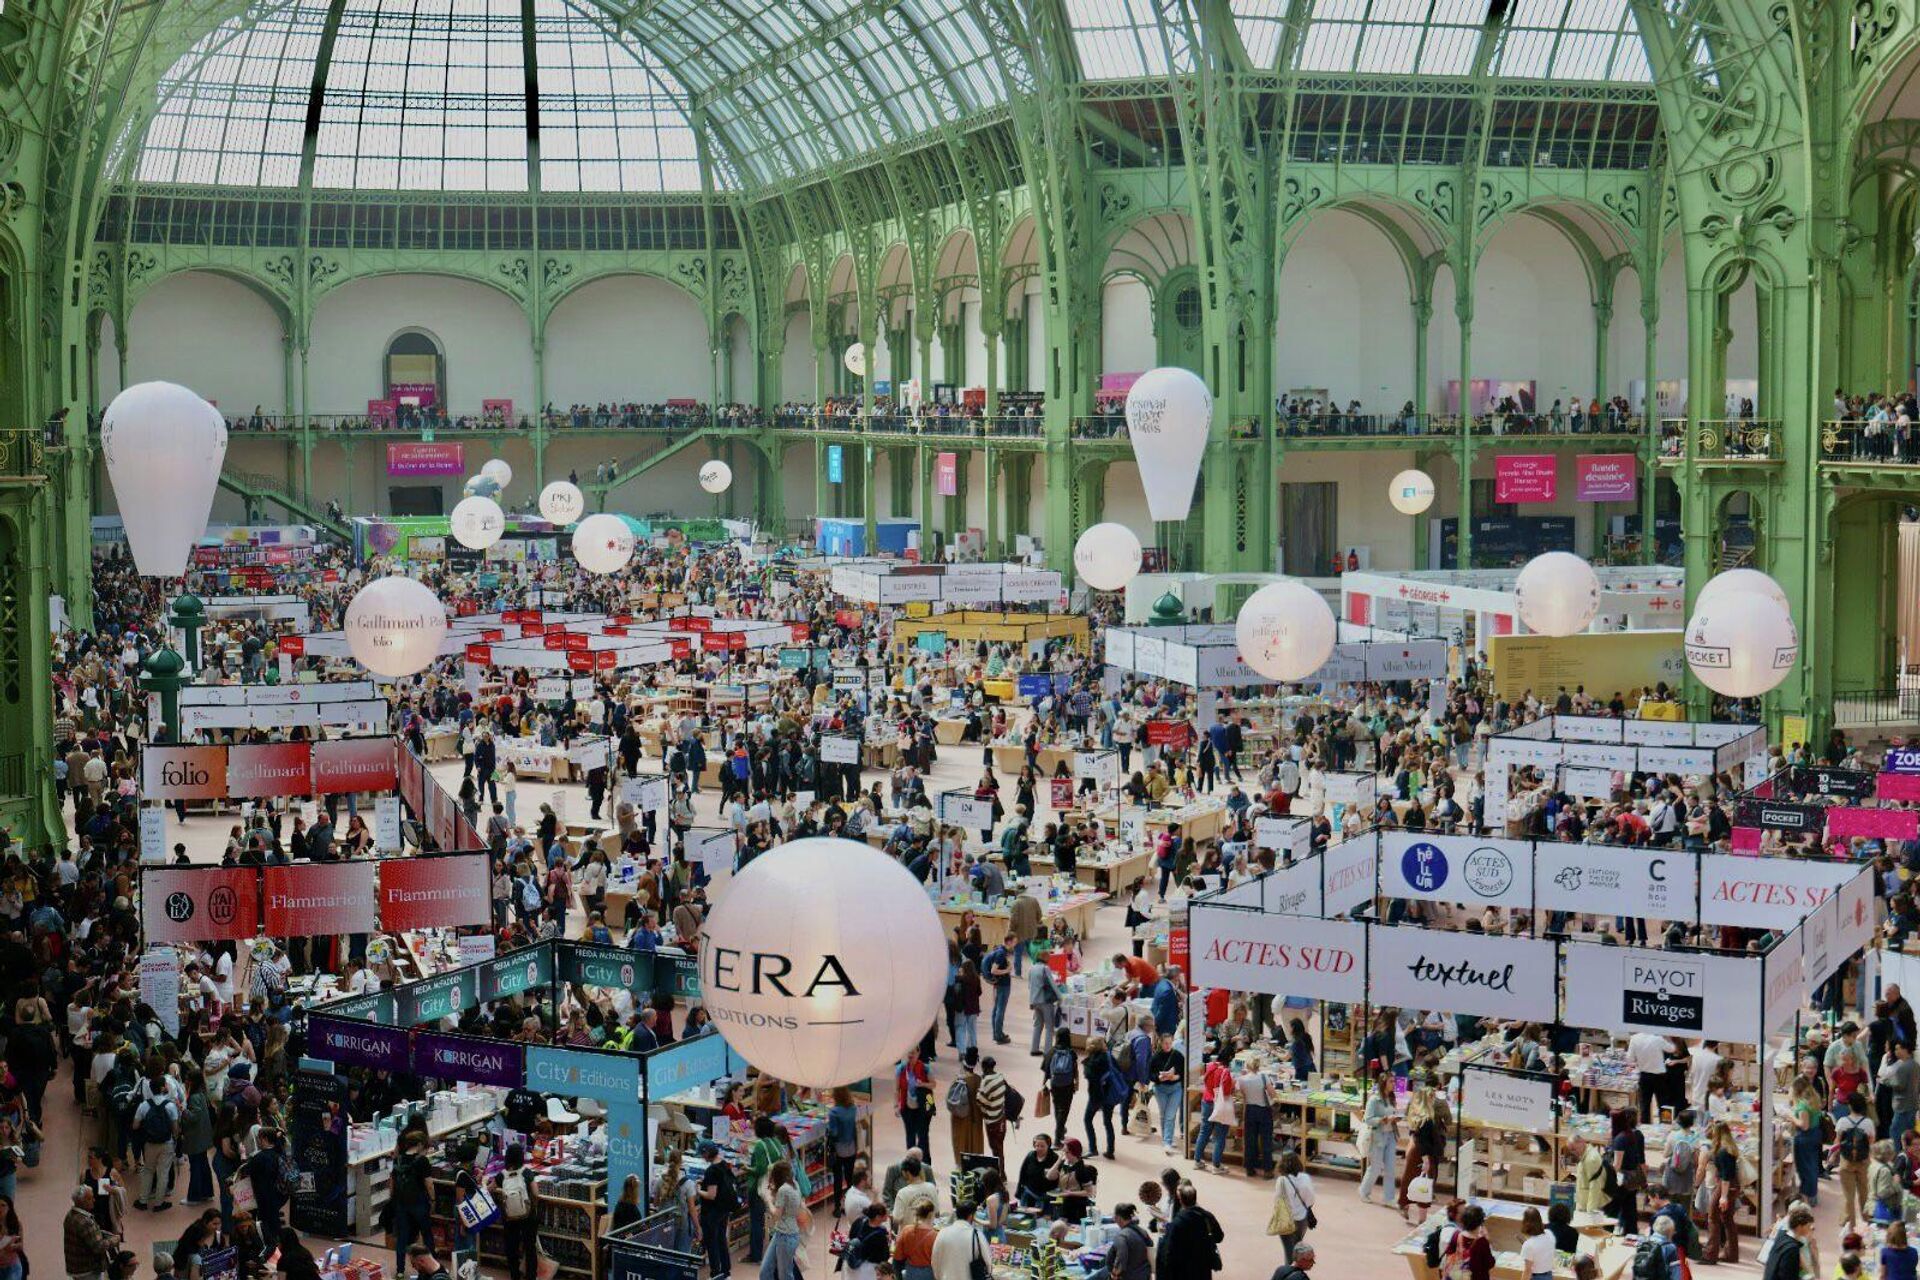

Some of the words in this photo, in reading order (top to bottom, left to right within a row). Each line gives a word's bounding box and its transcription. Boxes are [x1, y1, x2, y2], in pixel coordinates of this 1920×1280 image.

[357, 615, 424, 629] Gallimard
[161, 761, 209, 786] folio
[233, 761, 305, 779] Gallimard
[319, 758, 391, 776] Gallimard
[1818, 773, 1829, 783] 10
[1818, 784, 1829, 793] 18
[1765, 813, 1800, 823] POCKET
[1470, 856, 1506, 868] ACTES
[1475, 868, 1499, 878] SUD
[271, 892, 373, 909] Flammarion
[387, 885, 483, 904] Flammarion
[1713, 881, 1798, 907] ACTES
[1204, 937, 1291, 968] ACTES
[1296, 946, 1355, 975] SUD
[1407, 955, 1517, 995] textuel
[1634, 966, 1697, 989] PAYOT
[1656, 987, 1670, 1001] &
[1632, 998, 1696, 1022] Rivages
[535, 1061, 571, 1084] City
[581, 1068, 631, 1091] Editions
[654, 1066, 679, 1087] City
[1485, 1090, 1503, 1100] LES
[1507, 1095, 1535, 1105] MOTS
[609, 1137, 642, 1157] City
